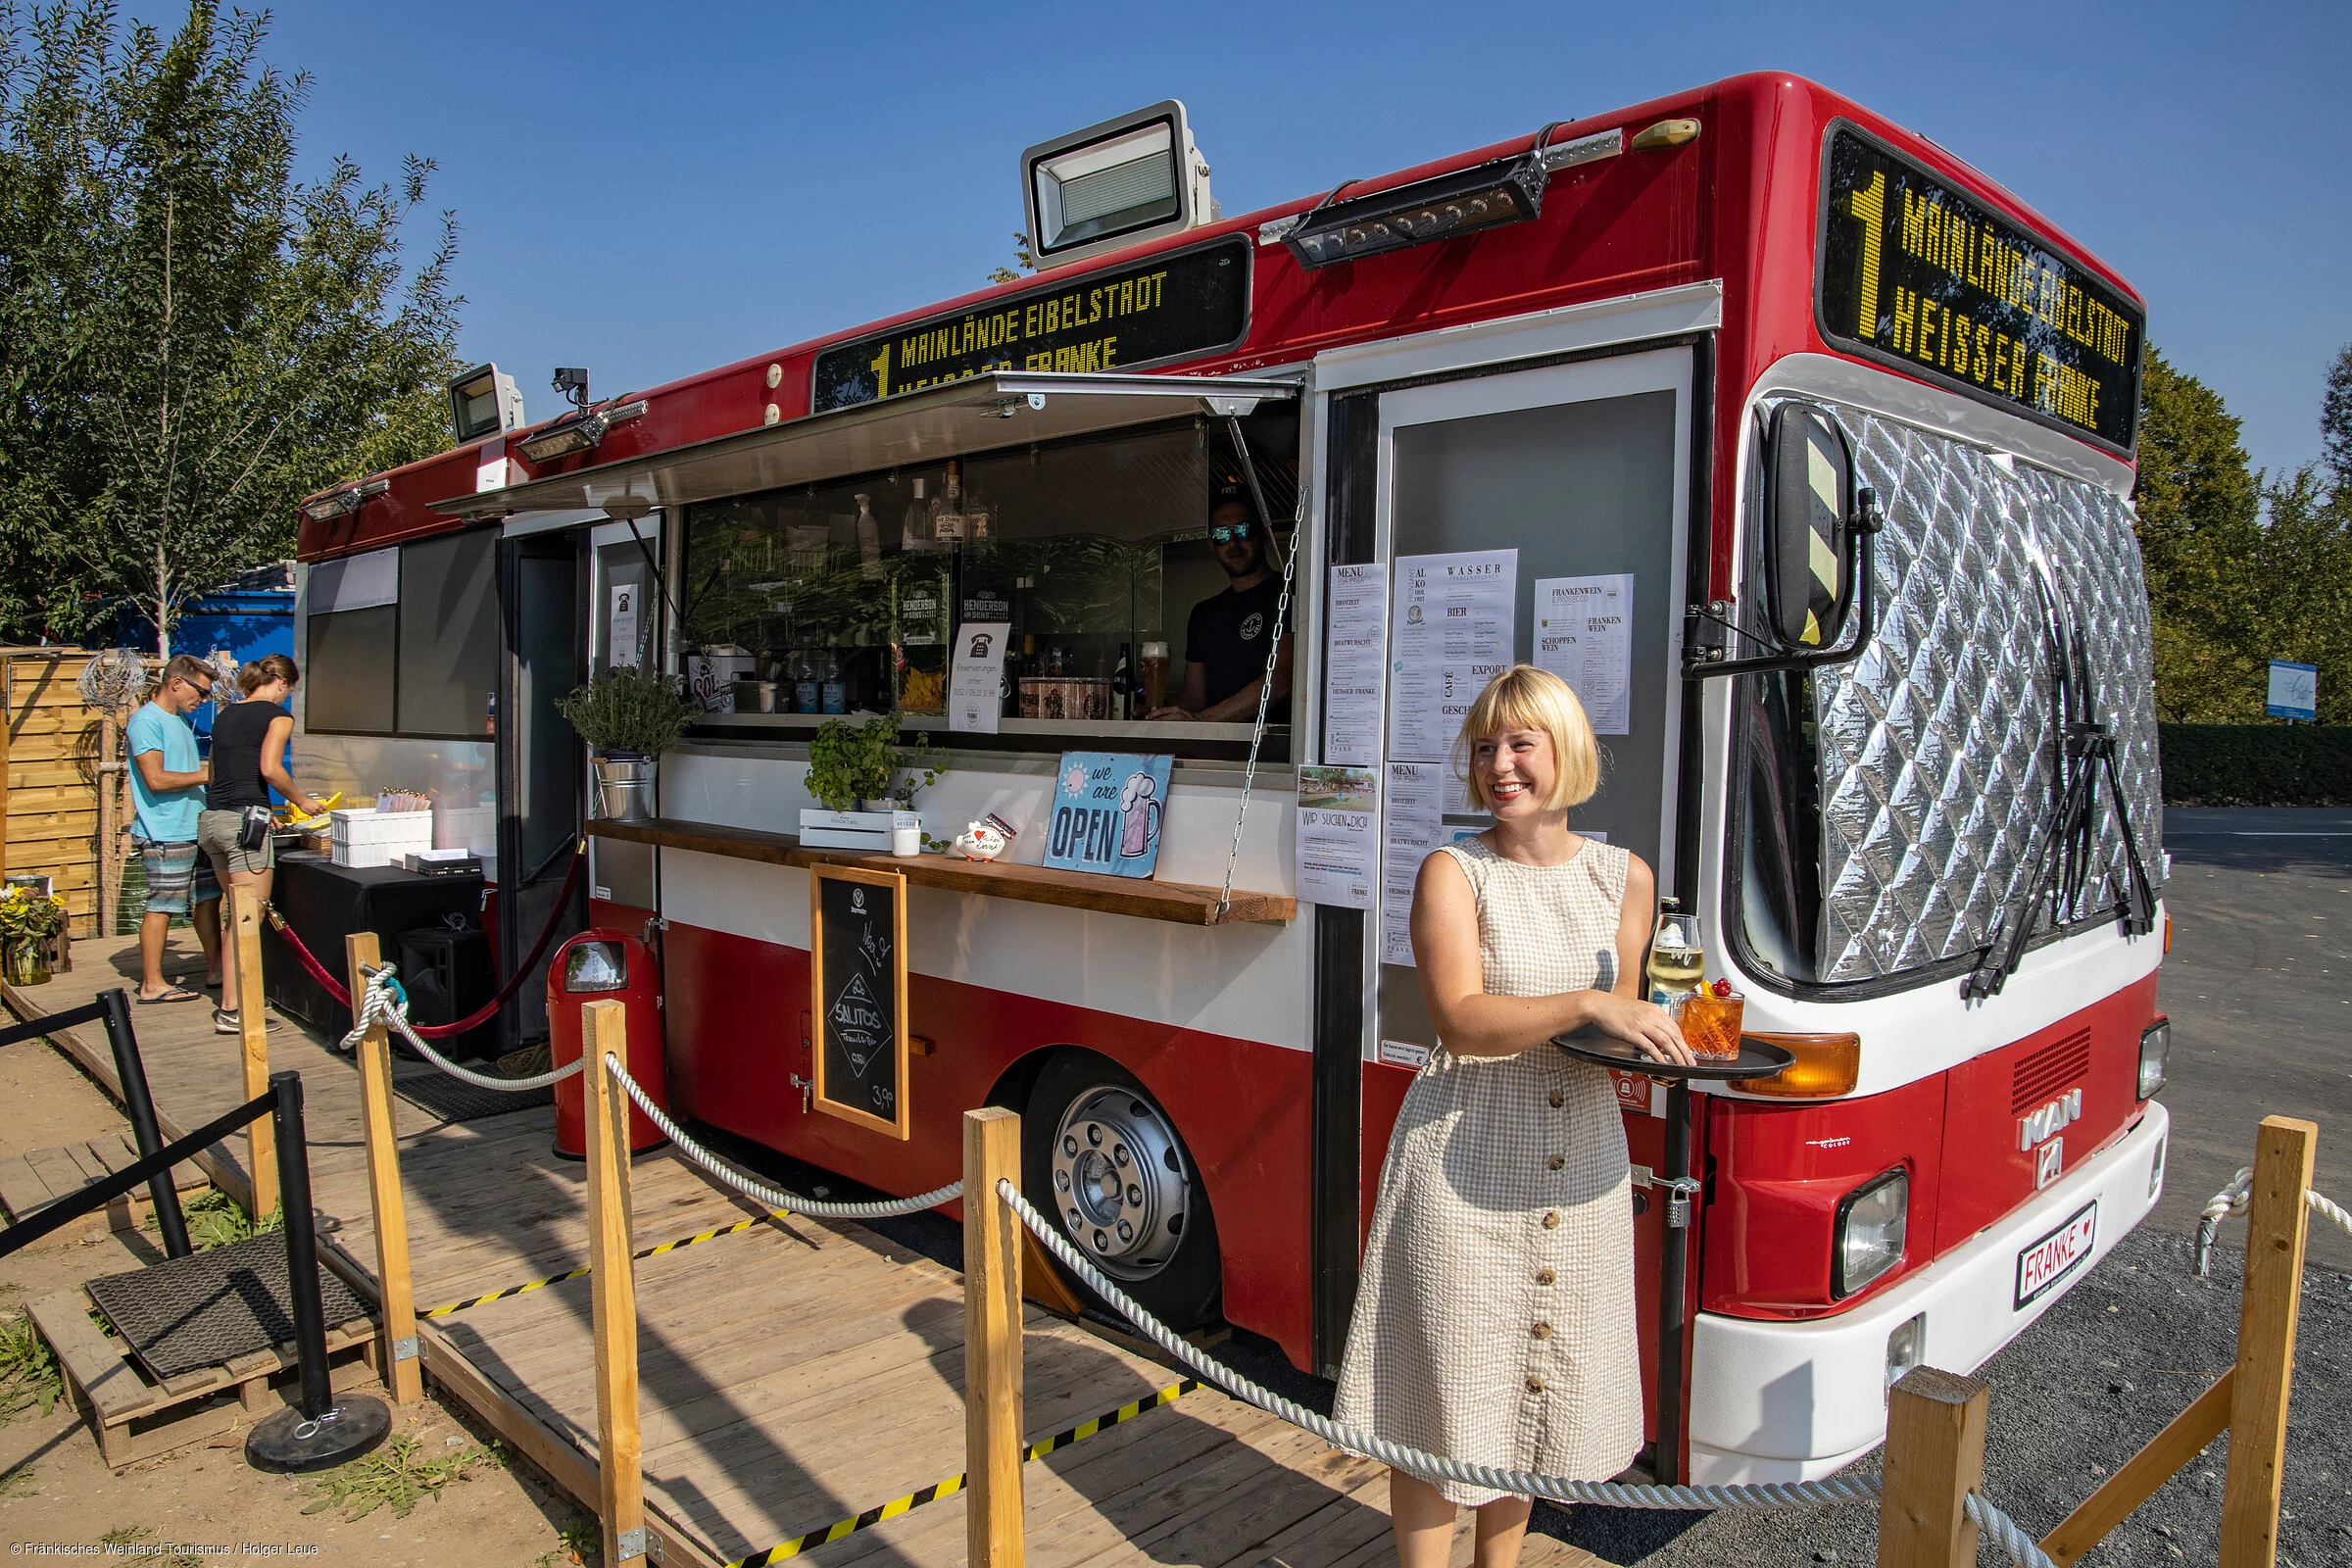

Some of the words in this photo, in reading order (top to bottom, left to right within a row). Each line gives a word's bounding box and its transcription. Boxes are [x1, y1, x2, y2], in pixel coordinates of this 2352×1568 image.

[1852, 171, 1886, 339] 1
[1902, 187, 2037, 316] MAINLÄNDE
[2038, 269, 2130, 368] EIBELSTADT
[870, 343, 891, 400] 1
[901, 308, 1019, 369] MAINLÄNDE
[1024, 270, 1168, 339] EIBELSTADT
[1025, 336, 1117, 373] FRANKE
[1892, 285, 2027, 398] HEISSER
[2034, 352, 2101, 430] FRANKE
[1337, 566, 1364, 578] MENU
[1415, 567, 1427, 578] AL
[1415, 579, 1426, 588] KO
[1551, 586, 1602, 597] FRANKENWEIN
[903, 599, 937, 612] HENDERSON
[963, 599, 1008, 612] HENDERSON
[1556, 595, 1589, 604] PROSECCO
[909, 611, 922, 619] SONS
[1446, 607, 1467, 617] BIER
[1588, 615, 1622, 625] FRANKEN
[1541, 636, 1577, 645] SCHOPPEN
[956, 662, 998, 674] Reservierungen
[1472, 664, 1507, 675] EXPORT
[1444, 671, 1453, 698] CAFÉ
[1442, 705, 1471, 715] GESCH
[1091, 766, 1112, 781] we
[1391, 764, 1419, 776] MENU
[1092, 785, 1118, 801] are
[1391, 797, 1417, 806] BROTZEIT
[1301, 810, 1318, 826] WIR
[1321, 812, 1348, 827] SUCHEN
[1350, 815, 1368, 829] DICH
[1051, 806, 1119, 862] OPEN
[1390, 838, 1430, 847] BRATWURSCHT
[1350, 888, 1368, 897] FRANKE
[1388, 887, 1411, 896] HEISSER
[835, 1003, 882, 1029] SALITOS
[2019, 1088, 2082, 1152] MAN
[2024, 1223, 2078, 1292] FRANKE
